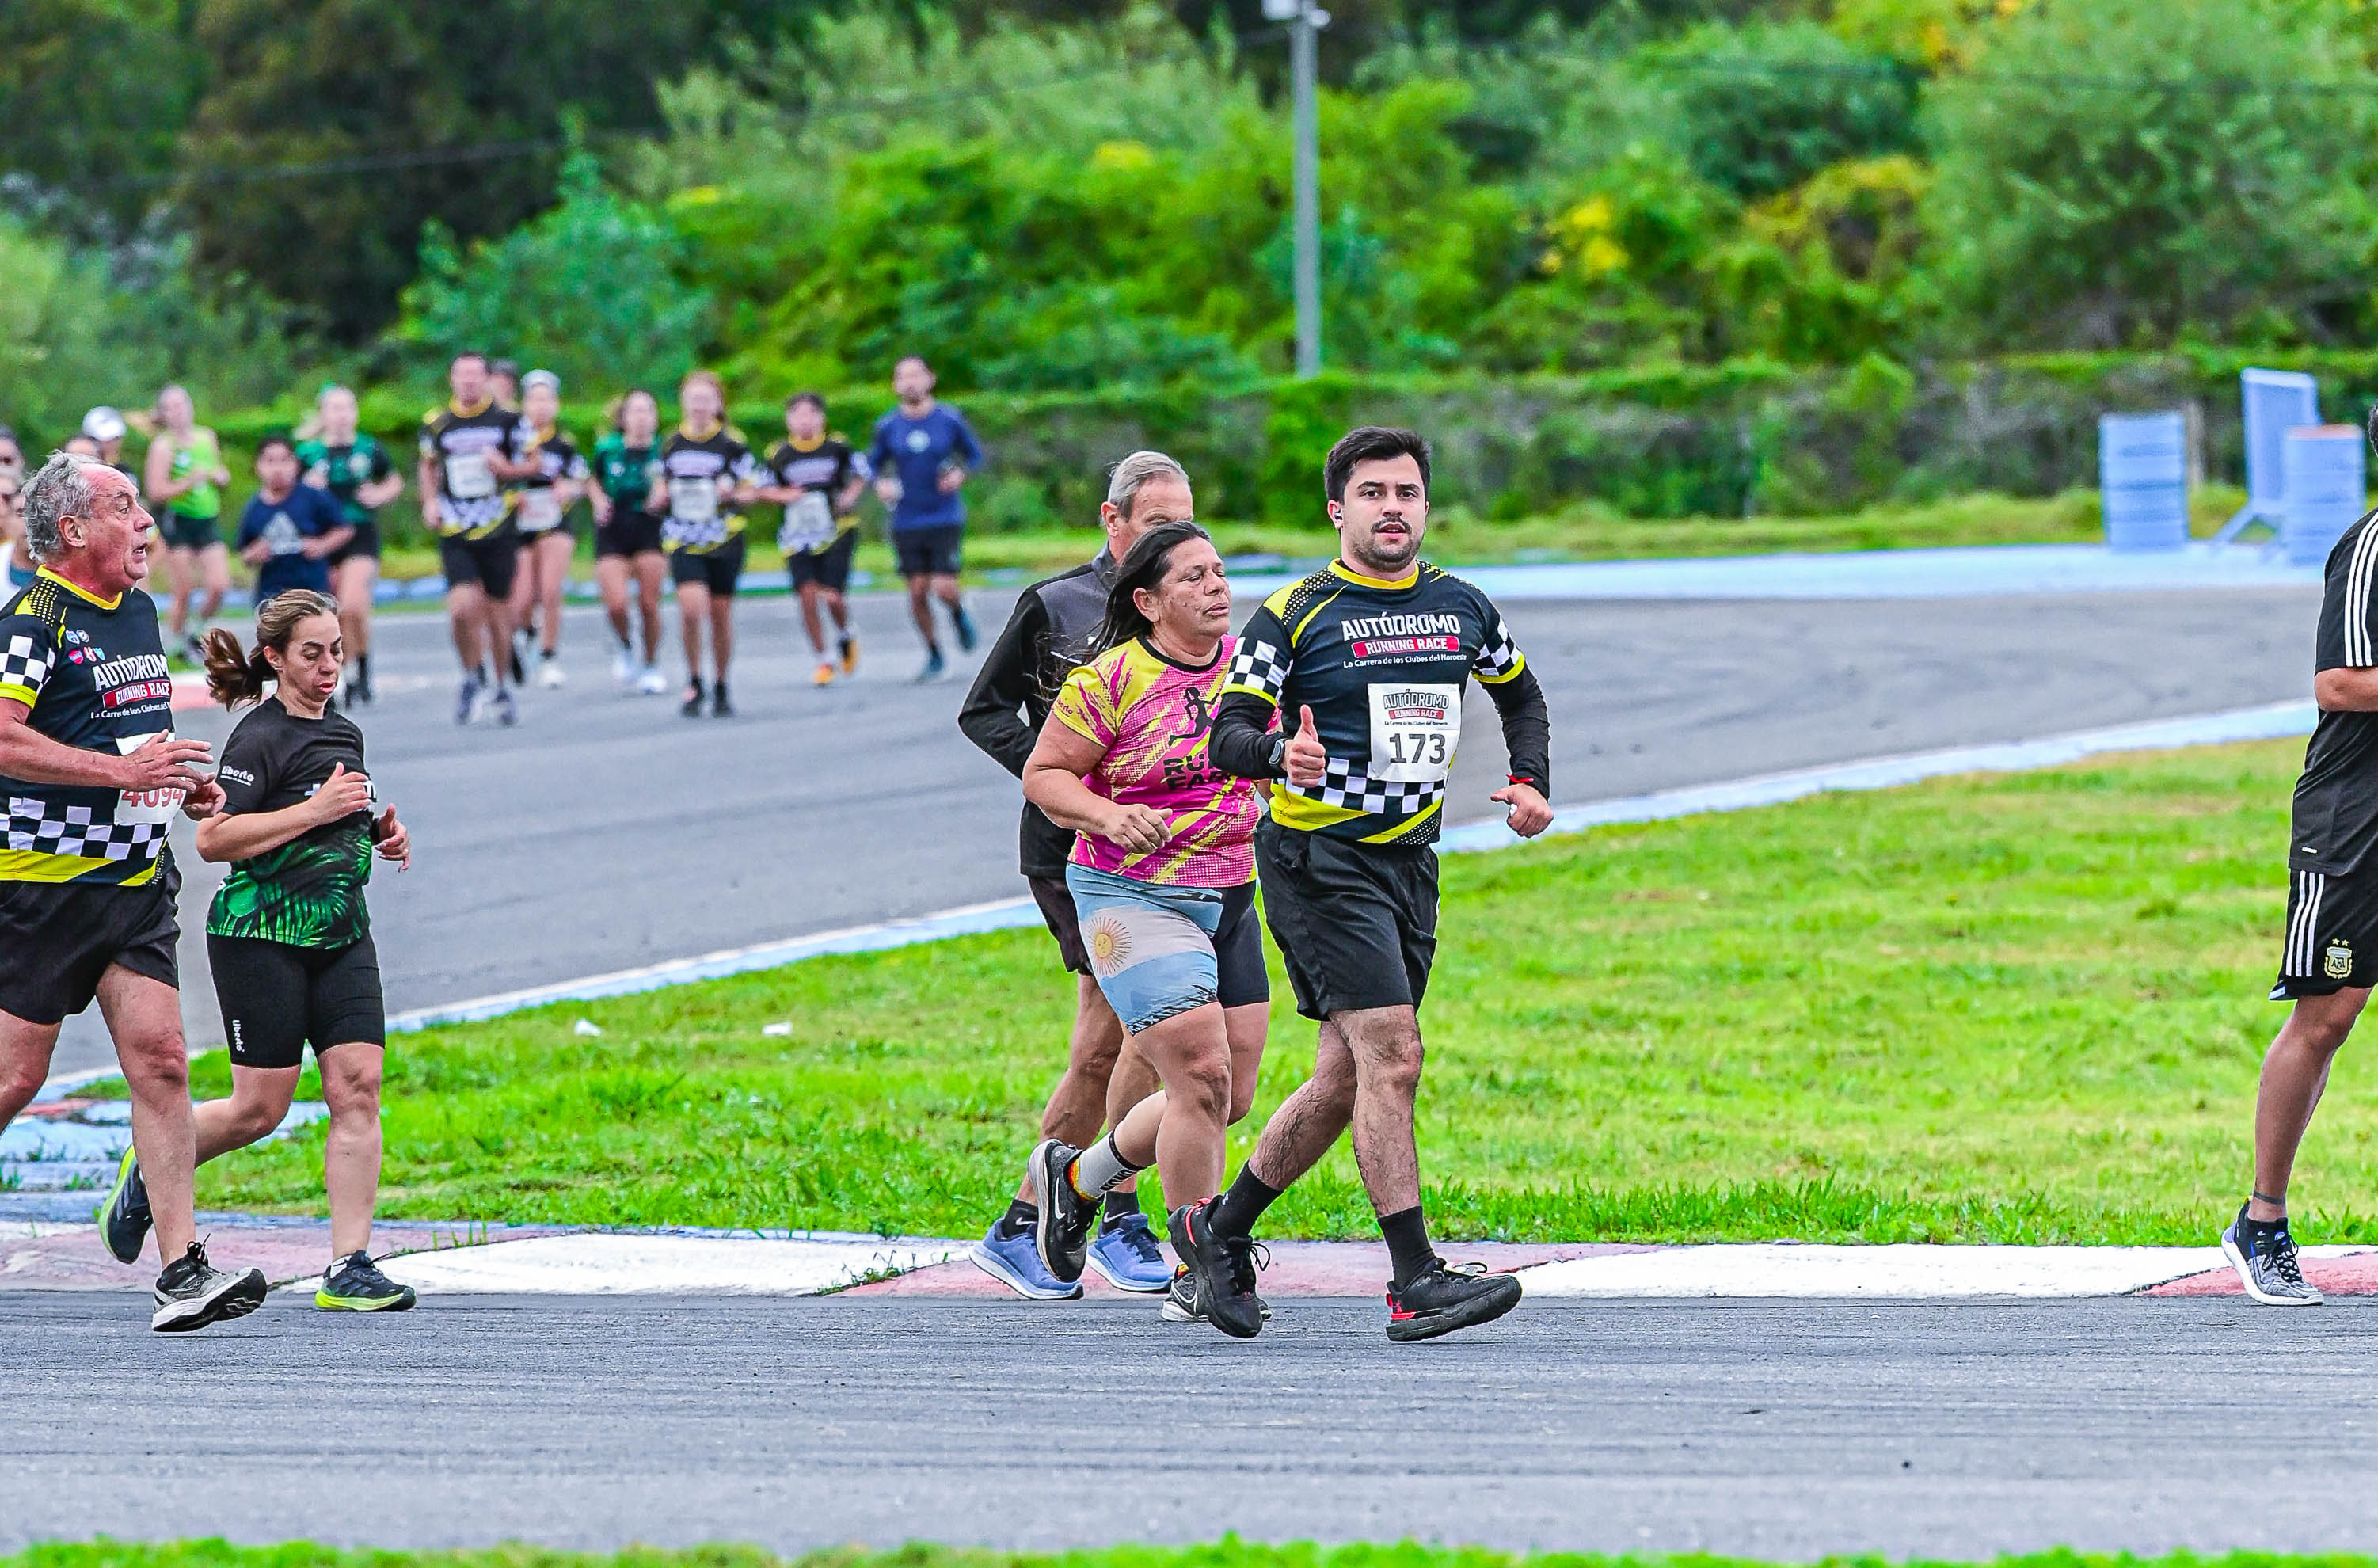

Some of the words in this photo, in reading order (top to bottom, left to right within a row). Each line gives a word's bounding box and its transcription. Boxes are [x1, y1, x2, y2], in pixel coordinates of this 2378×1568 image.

[1341, 611, 1462, 641] AUTÓDROMO
[1364, 638, 1415, 655] RUNNING
[1417, 637, 1448, 650] RACE
[1354, 657, 1383, 667] Carrera
[1383, 656, 1393, 664] de
[1393, 654, 1404, 664] los
[1405, 653, 1429, 662] Clubes
[1429, 653, 1440, 661] del
[1440, 653, 1467, 661] Noroeste
[92, 654, 170, 692] AUTÓDROM
[115, 683, 148, 706] RUNNING
[147, 682, 171, 697] RACE
[1383, 689, 1449, 710] AUTÓDROMO
[1389, 733, 1446, 765] 173
[1162, 753, 1206, 776] RU
[121, 789, 184, 808] 4094
